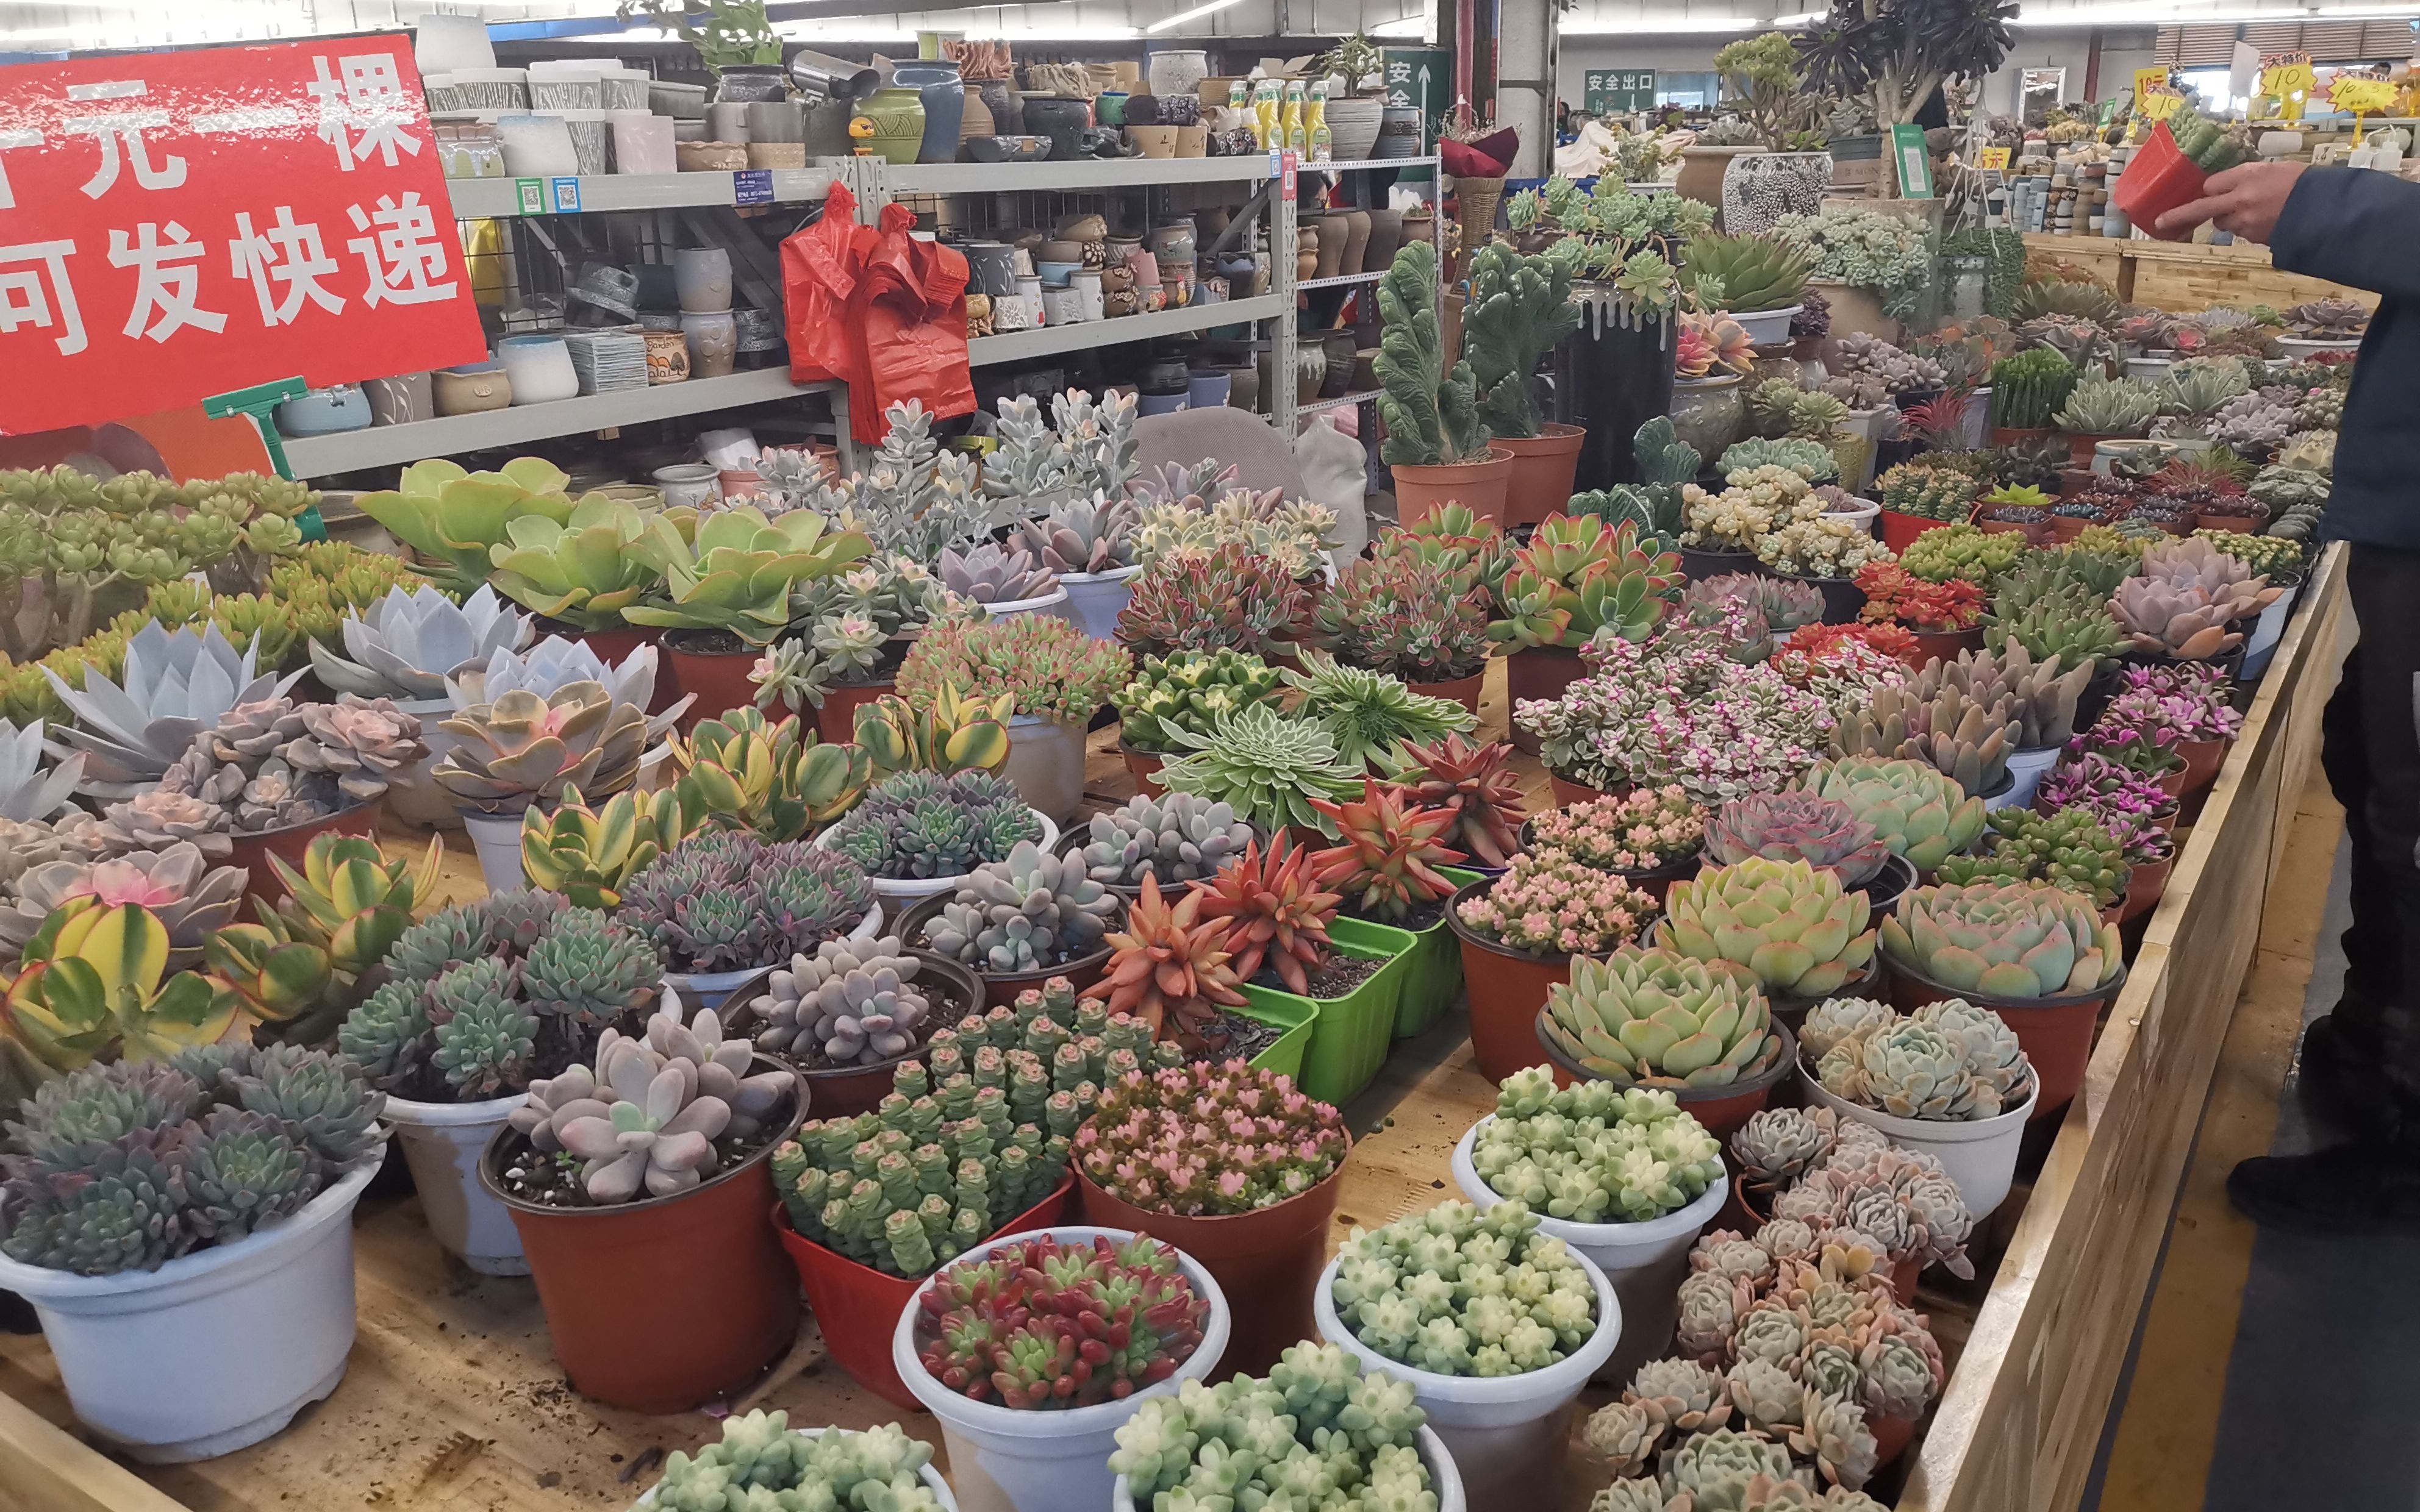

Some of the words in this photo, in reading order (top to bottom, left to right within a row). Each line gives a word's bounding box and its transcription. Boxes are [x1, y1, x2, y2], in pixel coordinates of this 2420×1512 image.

[2267, 52, 2307, 68] 大特价
[1588, 74, 1652, 91] 安全出口
[2274, 68, 2300, 90] 10
[0, 191, 459, 356] 可发快递
[646, 336, 675, 352] garden
